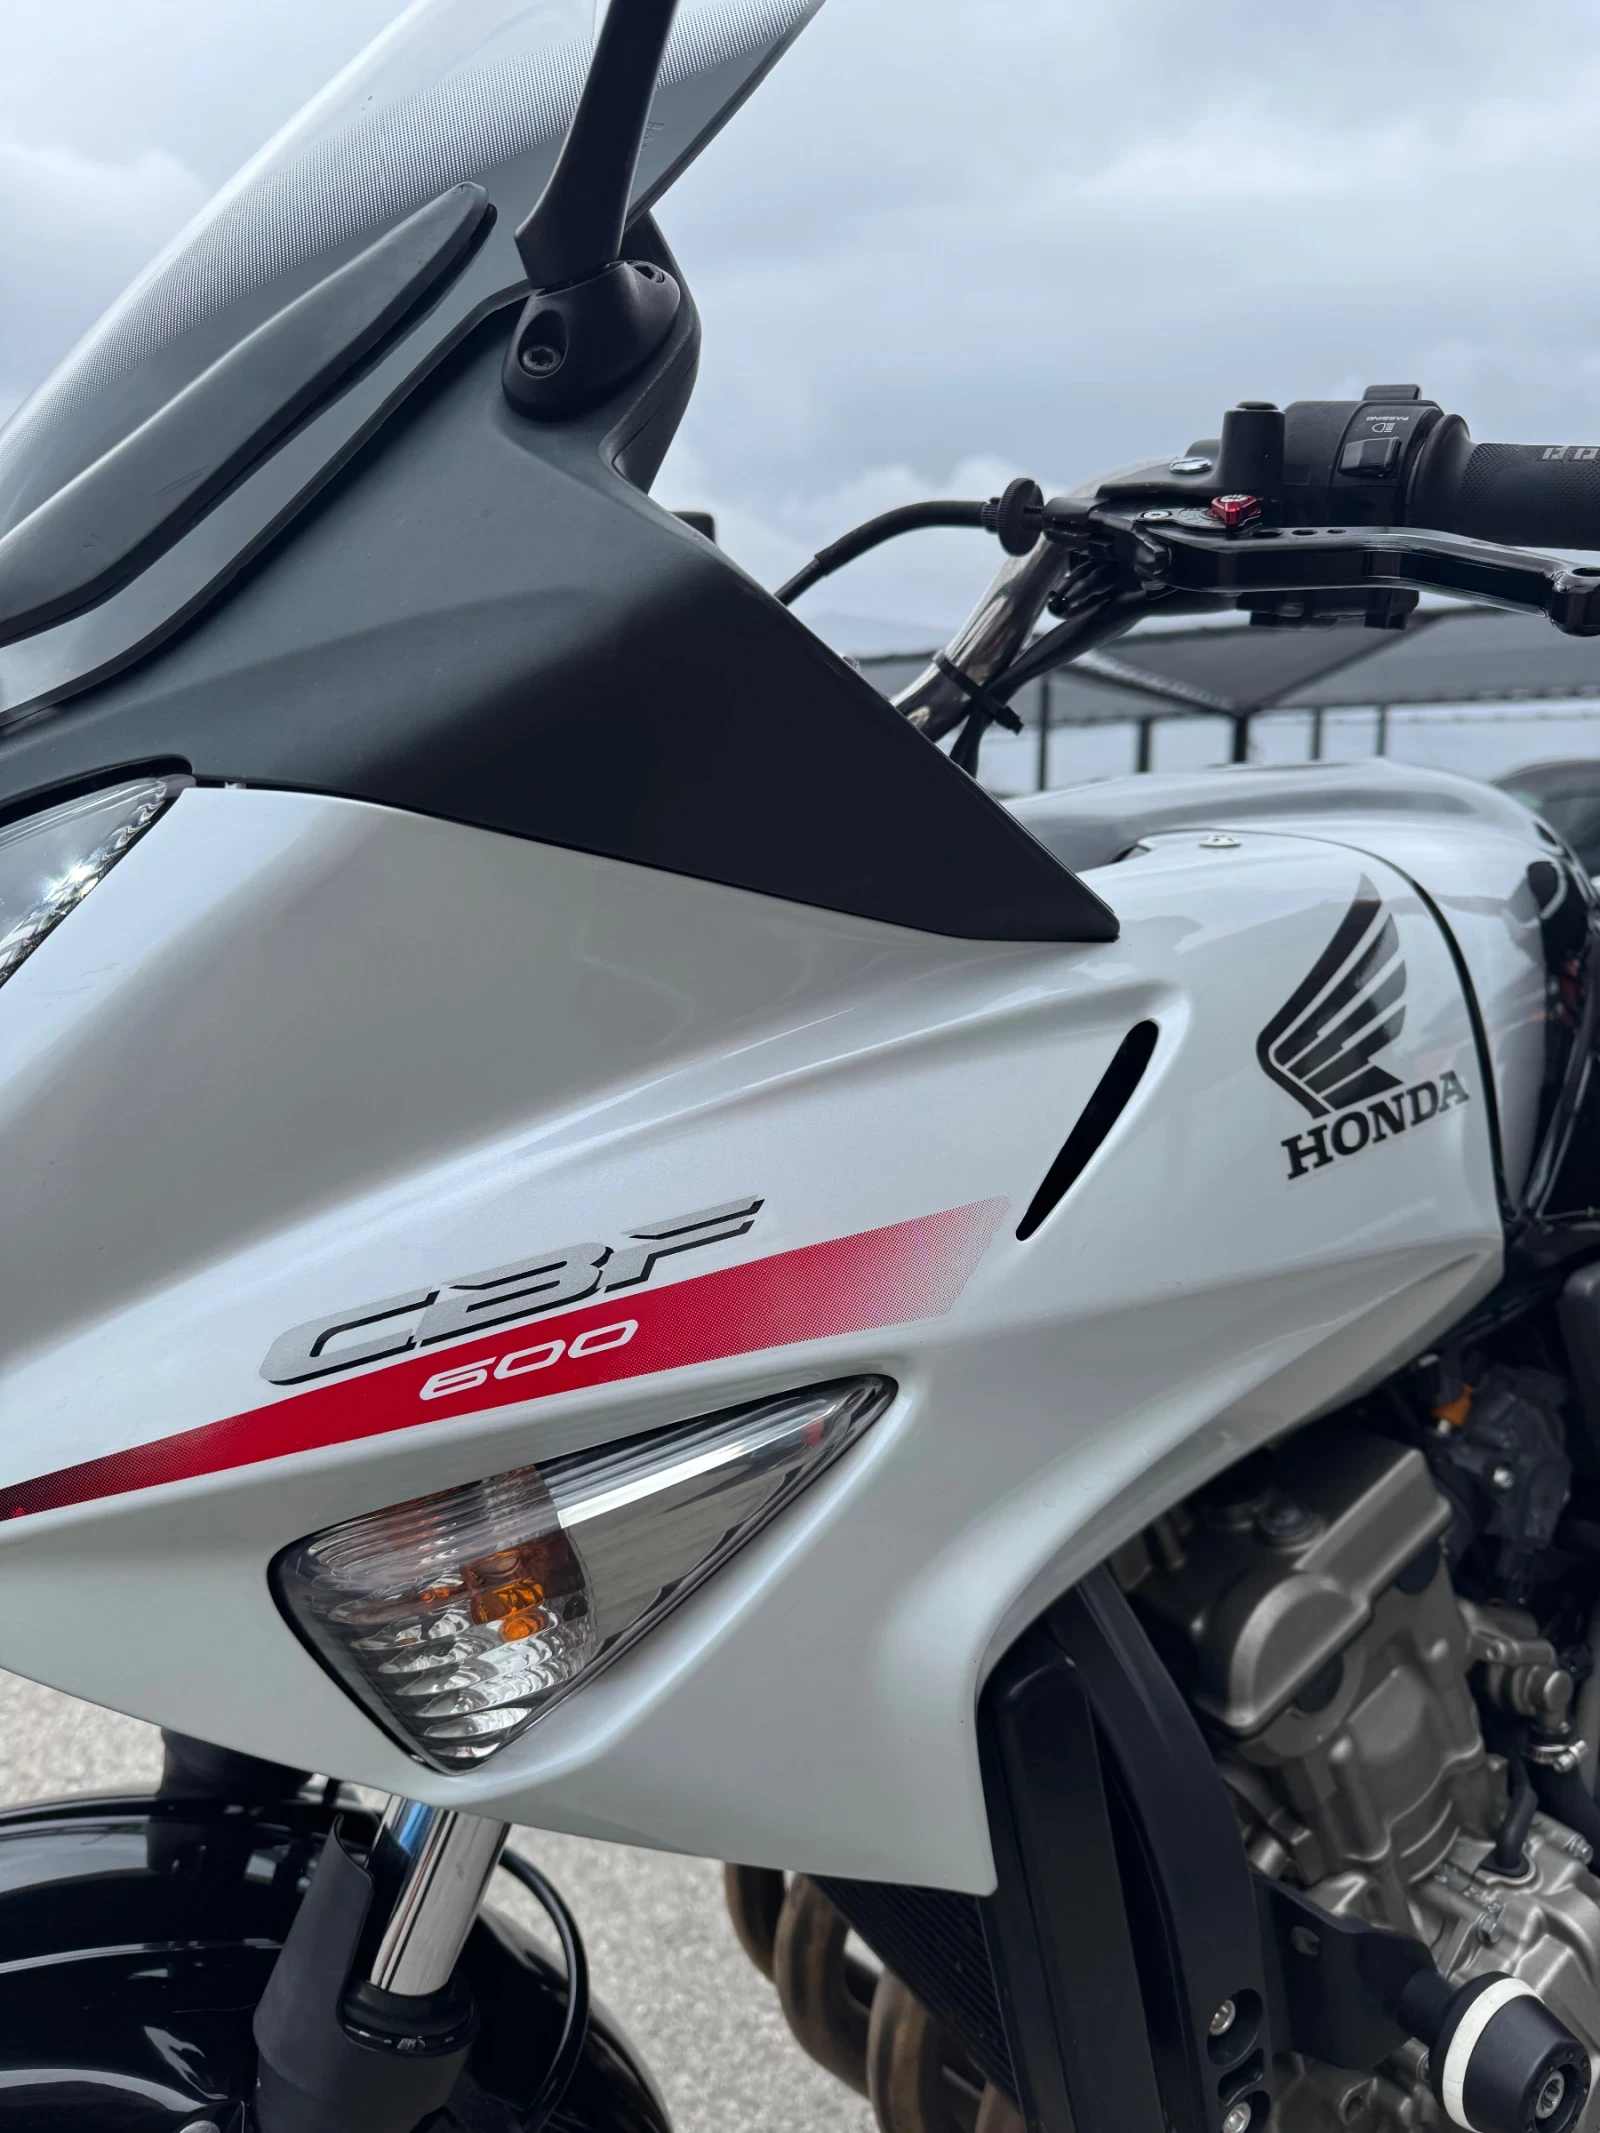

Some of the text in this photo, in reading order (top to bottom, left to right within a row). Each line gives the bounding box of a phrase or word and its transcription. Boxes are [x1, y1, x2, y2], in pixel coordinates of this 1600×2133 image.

[1280, 1070, 1470, 1181] HONDA
[258, 1193, 765, 1386] CBF
[419, 1319, 639, 1401] 600
